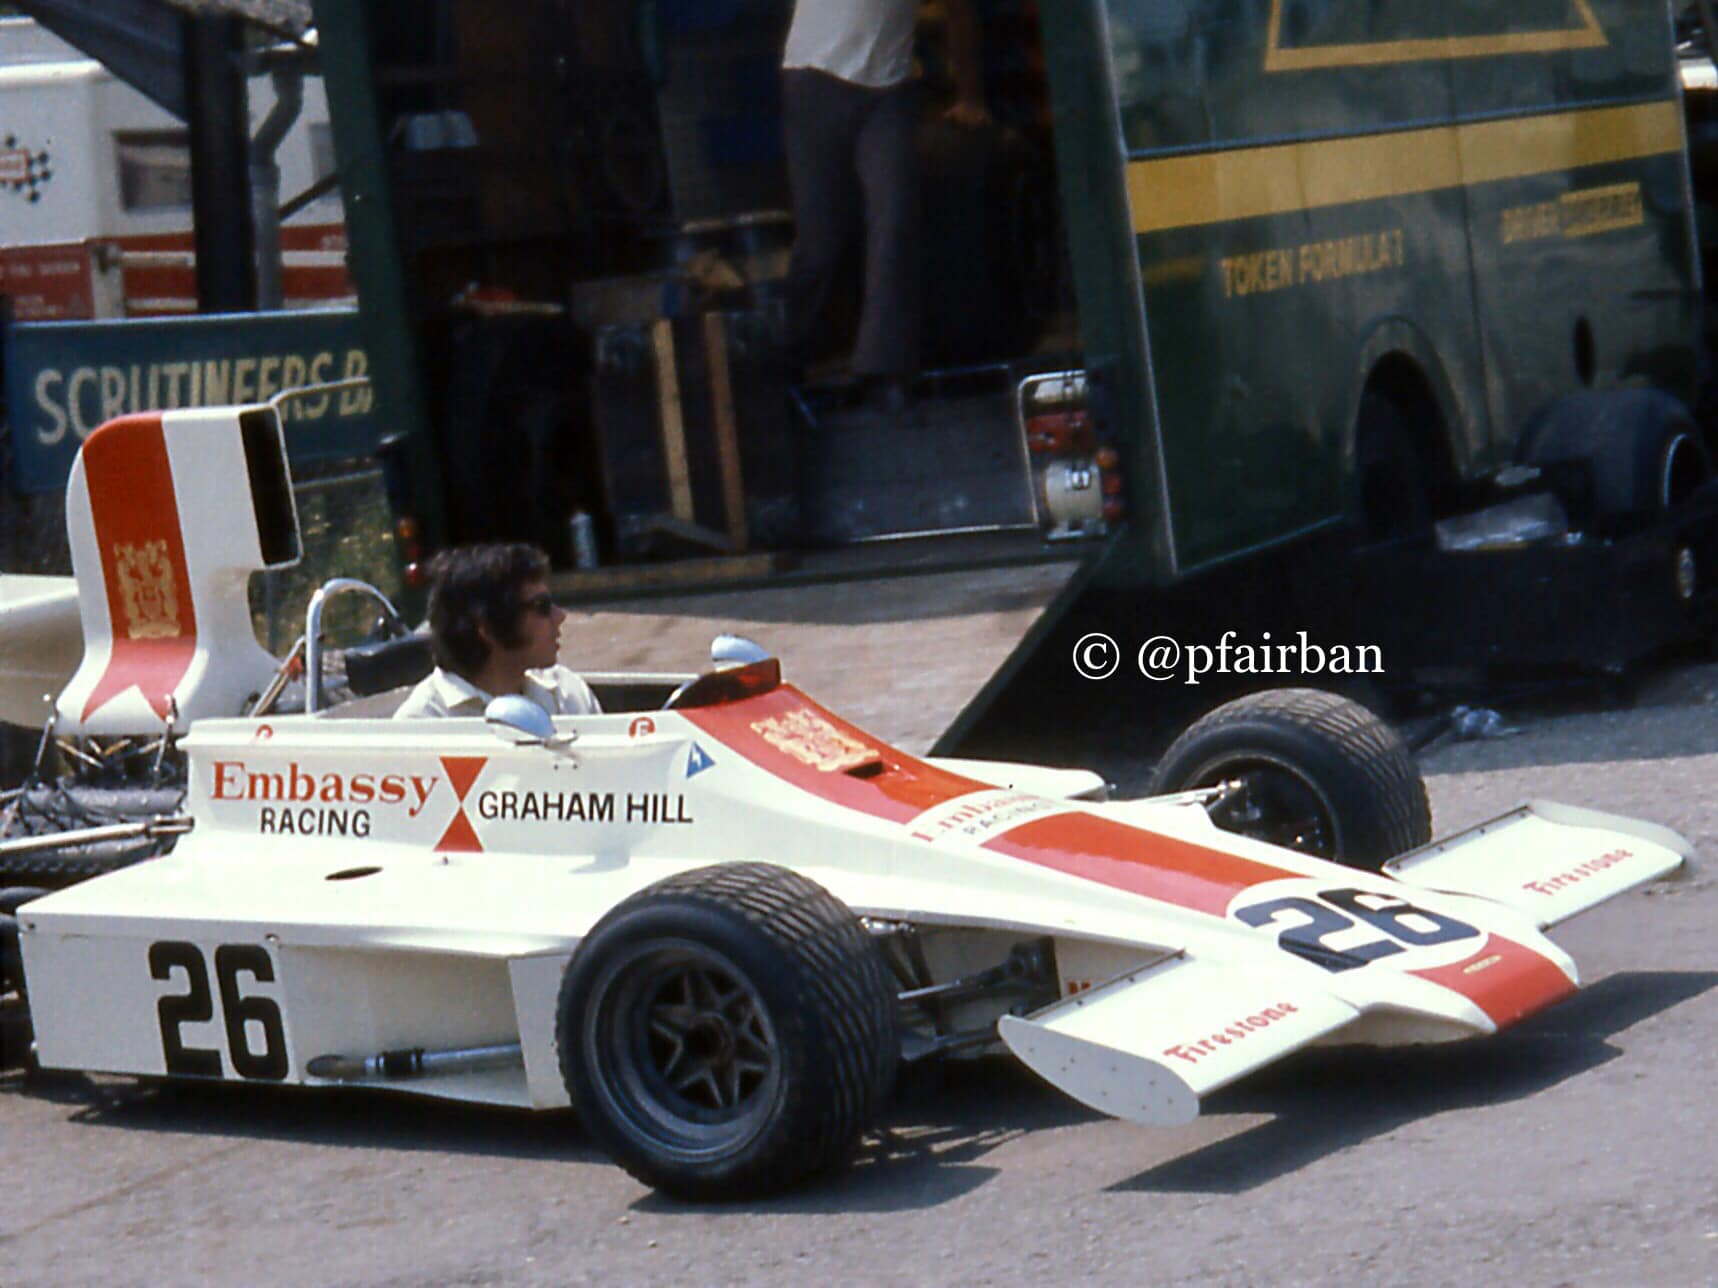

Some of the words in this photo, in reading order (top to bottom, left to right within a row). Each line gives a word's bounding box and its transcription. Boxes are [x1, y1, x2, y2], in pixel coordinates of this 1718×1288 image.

[1218, 248, 1294, 299] TOKEN
[212, 761, 439, 818] Embassy
[479, 790, 614, 823] GRAHAM
[626, 793, 693, 824] HILL
[260, 807, 371, 838] RACING
[1522, 848, 1634, 896] Firestone
[1233, 887, 1482, 973] 26
[148, 940, 289, 1081] 26
[1163, 1002, 1299, 1063] Firestone
